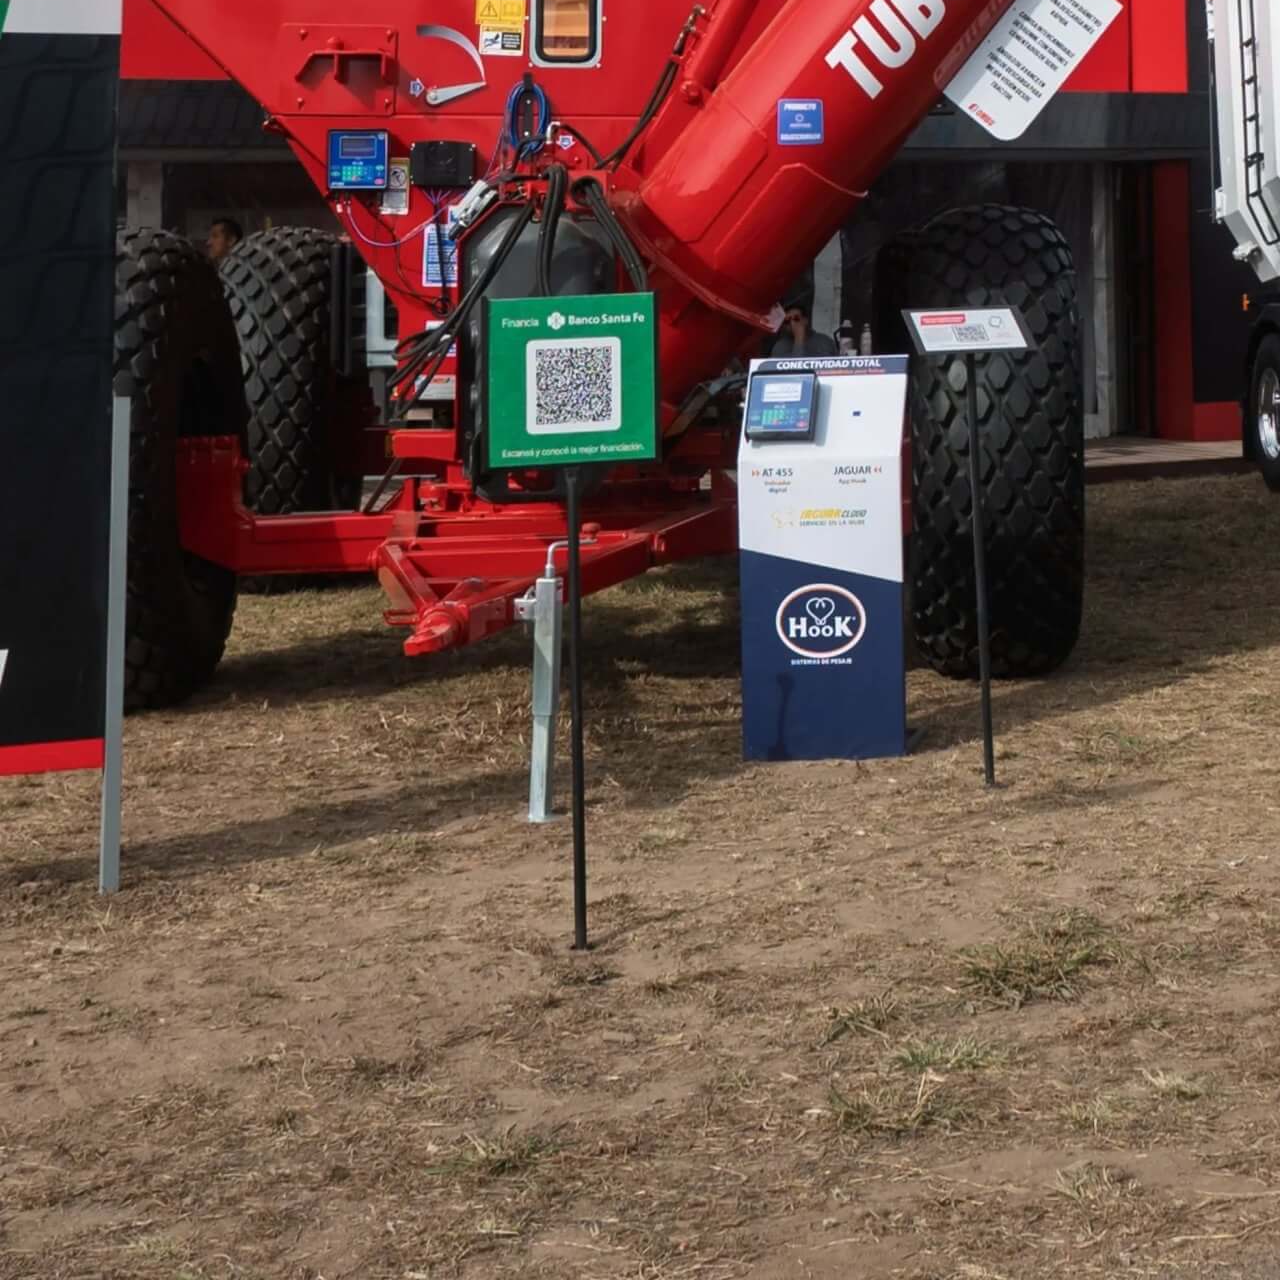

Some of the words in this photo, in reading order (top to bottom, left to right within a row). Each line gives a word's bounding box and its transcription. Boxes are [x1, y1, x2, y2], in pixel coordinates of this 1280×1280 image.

[502, 318, 539, 328] Financia
[568, 315, 600, 326] Banco
[601, 313, 631, 324] Santa
[632, 312, 645, 323] Fe
[776, 360, 850, 370] CONECTIVIDAD
[851, 358, 881, 368] TOTAL
[762, 469, 775, 477] AT
[776, 468, 793, 477] 455
[834, 466, 871, 475] JAGUAR
